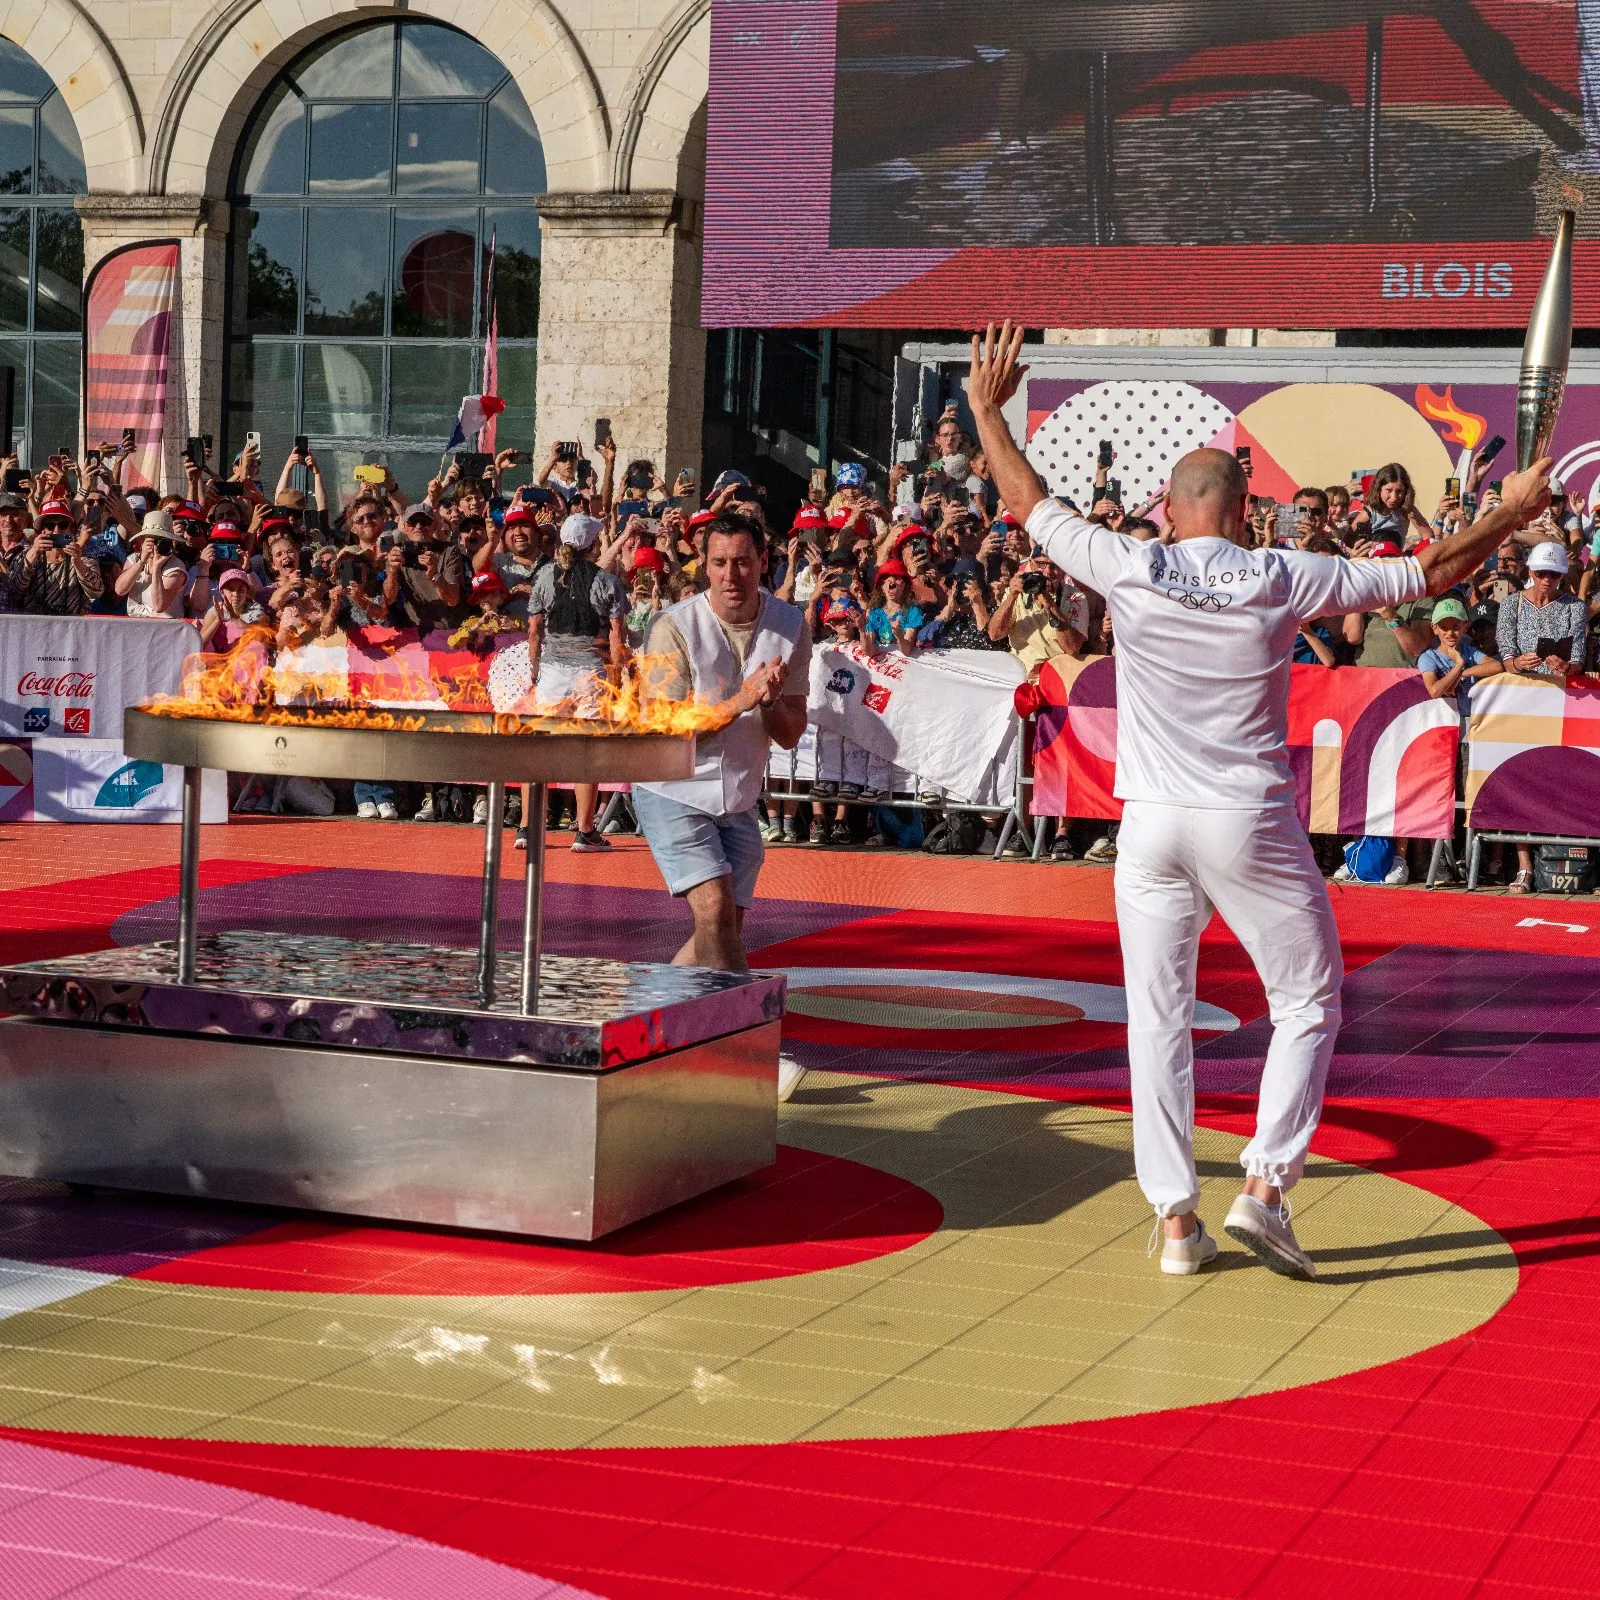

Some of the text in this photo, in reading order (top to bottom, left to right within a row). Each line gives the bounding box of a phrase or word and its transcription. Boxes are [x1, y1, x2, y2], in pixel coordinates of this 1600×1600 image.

[1381, 262, 1513, 298] BLOIS
[1208, 568, 1261, 587] 2024
[1551, 874, 1579, 890] 1971
